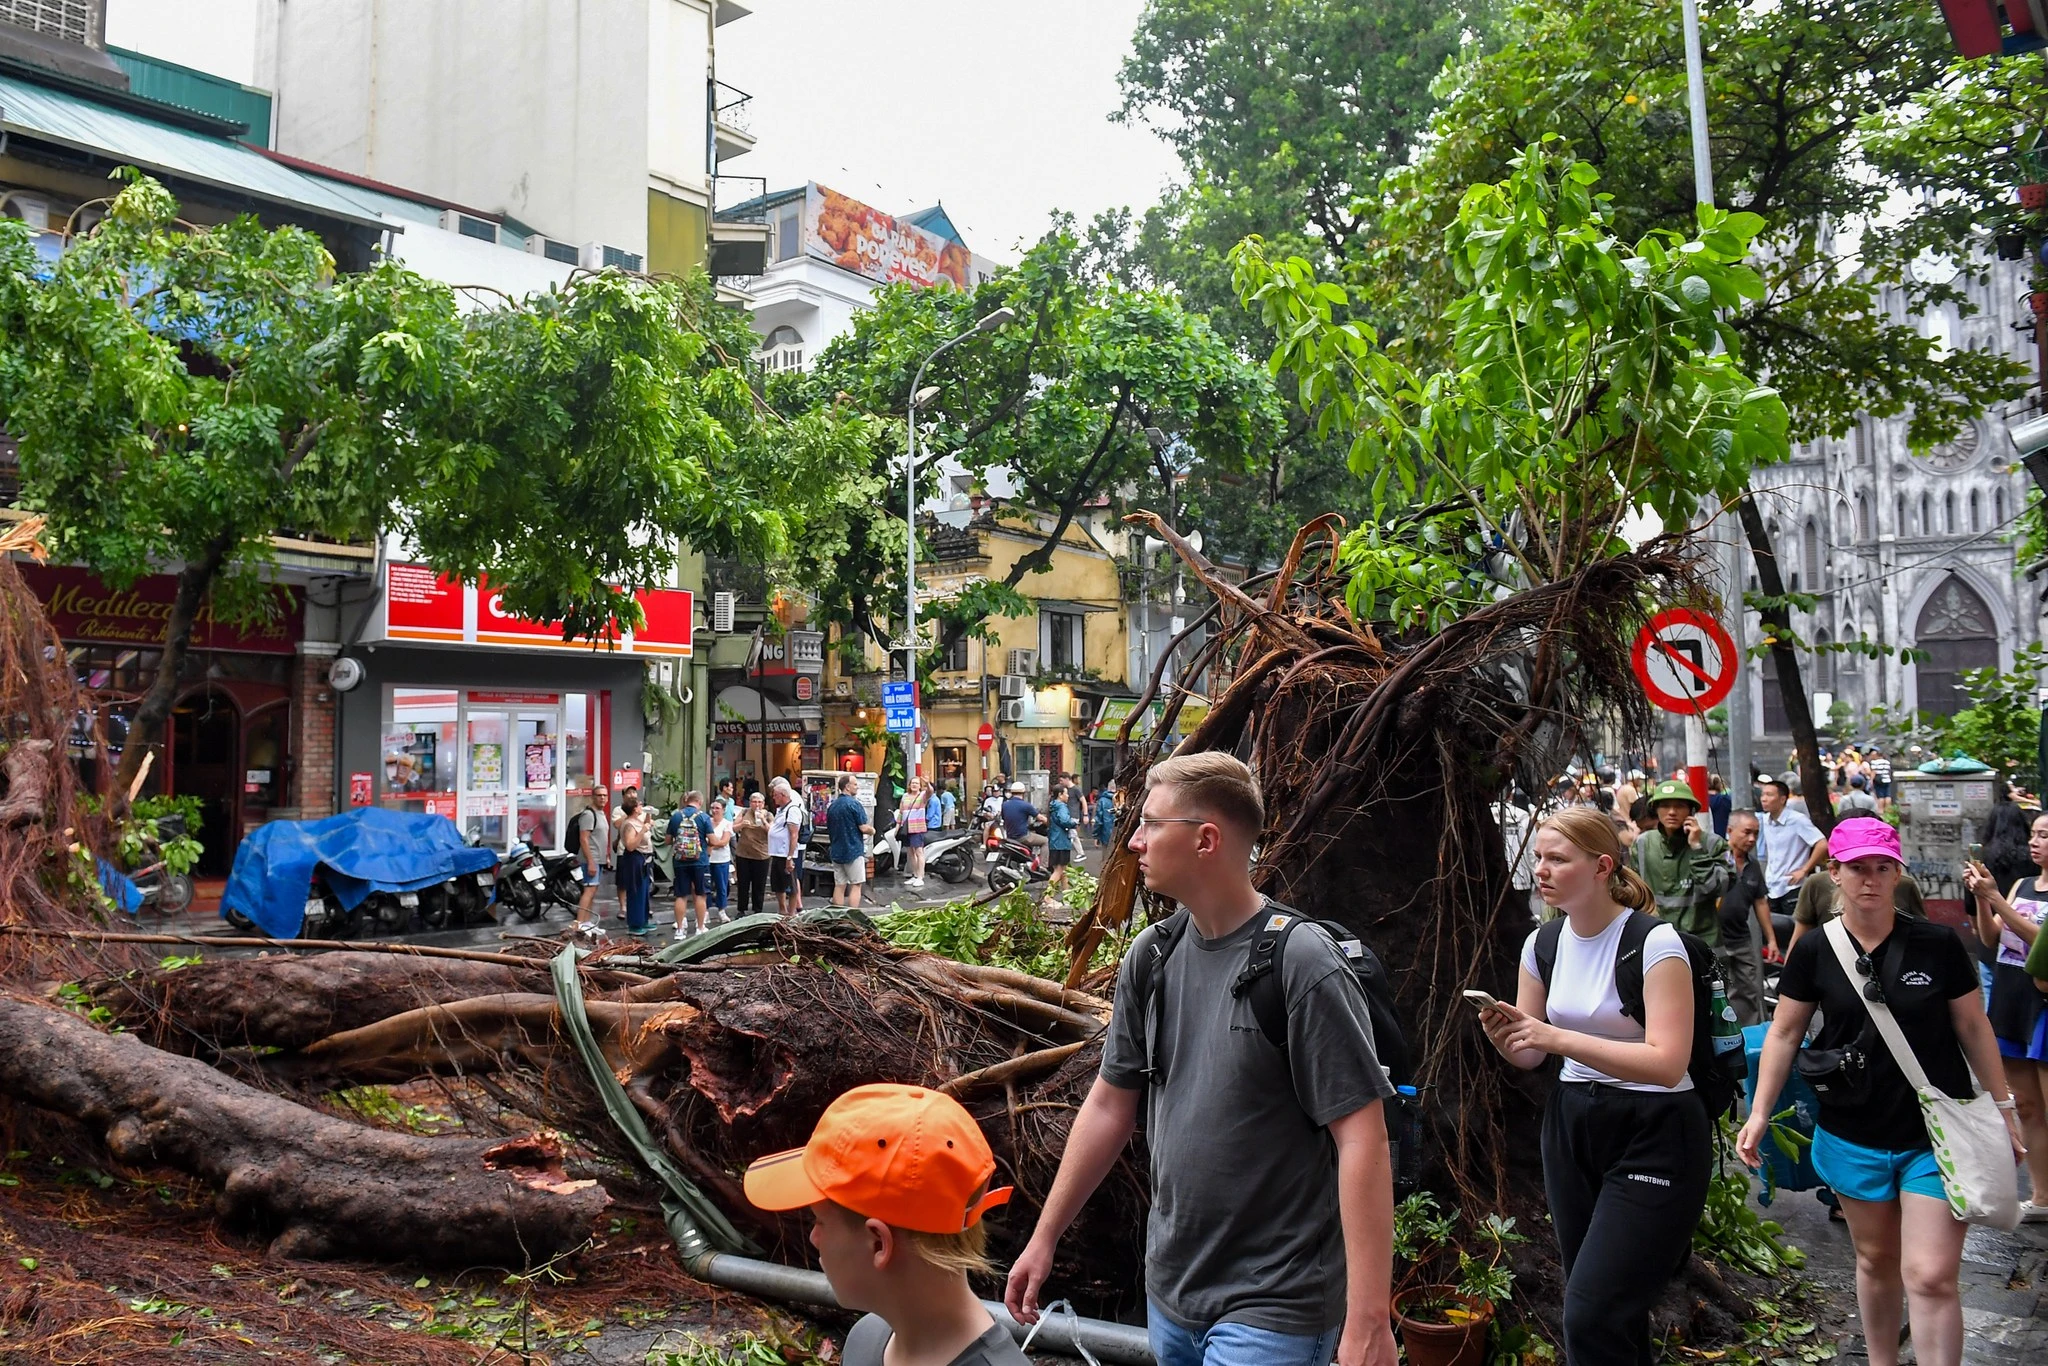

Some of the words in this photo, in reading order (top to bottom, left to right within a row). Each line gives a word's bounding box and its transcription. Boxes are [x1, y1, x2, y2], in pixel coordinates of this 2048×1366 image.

[872, 220, 890, 241] GÀ
[891, 228, 916, 254] RÁN
[763, 643, 784, 660] NG
